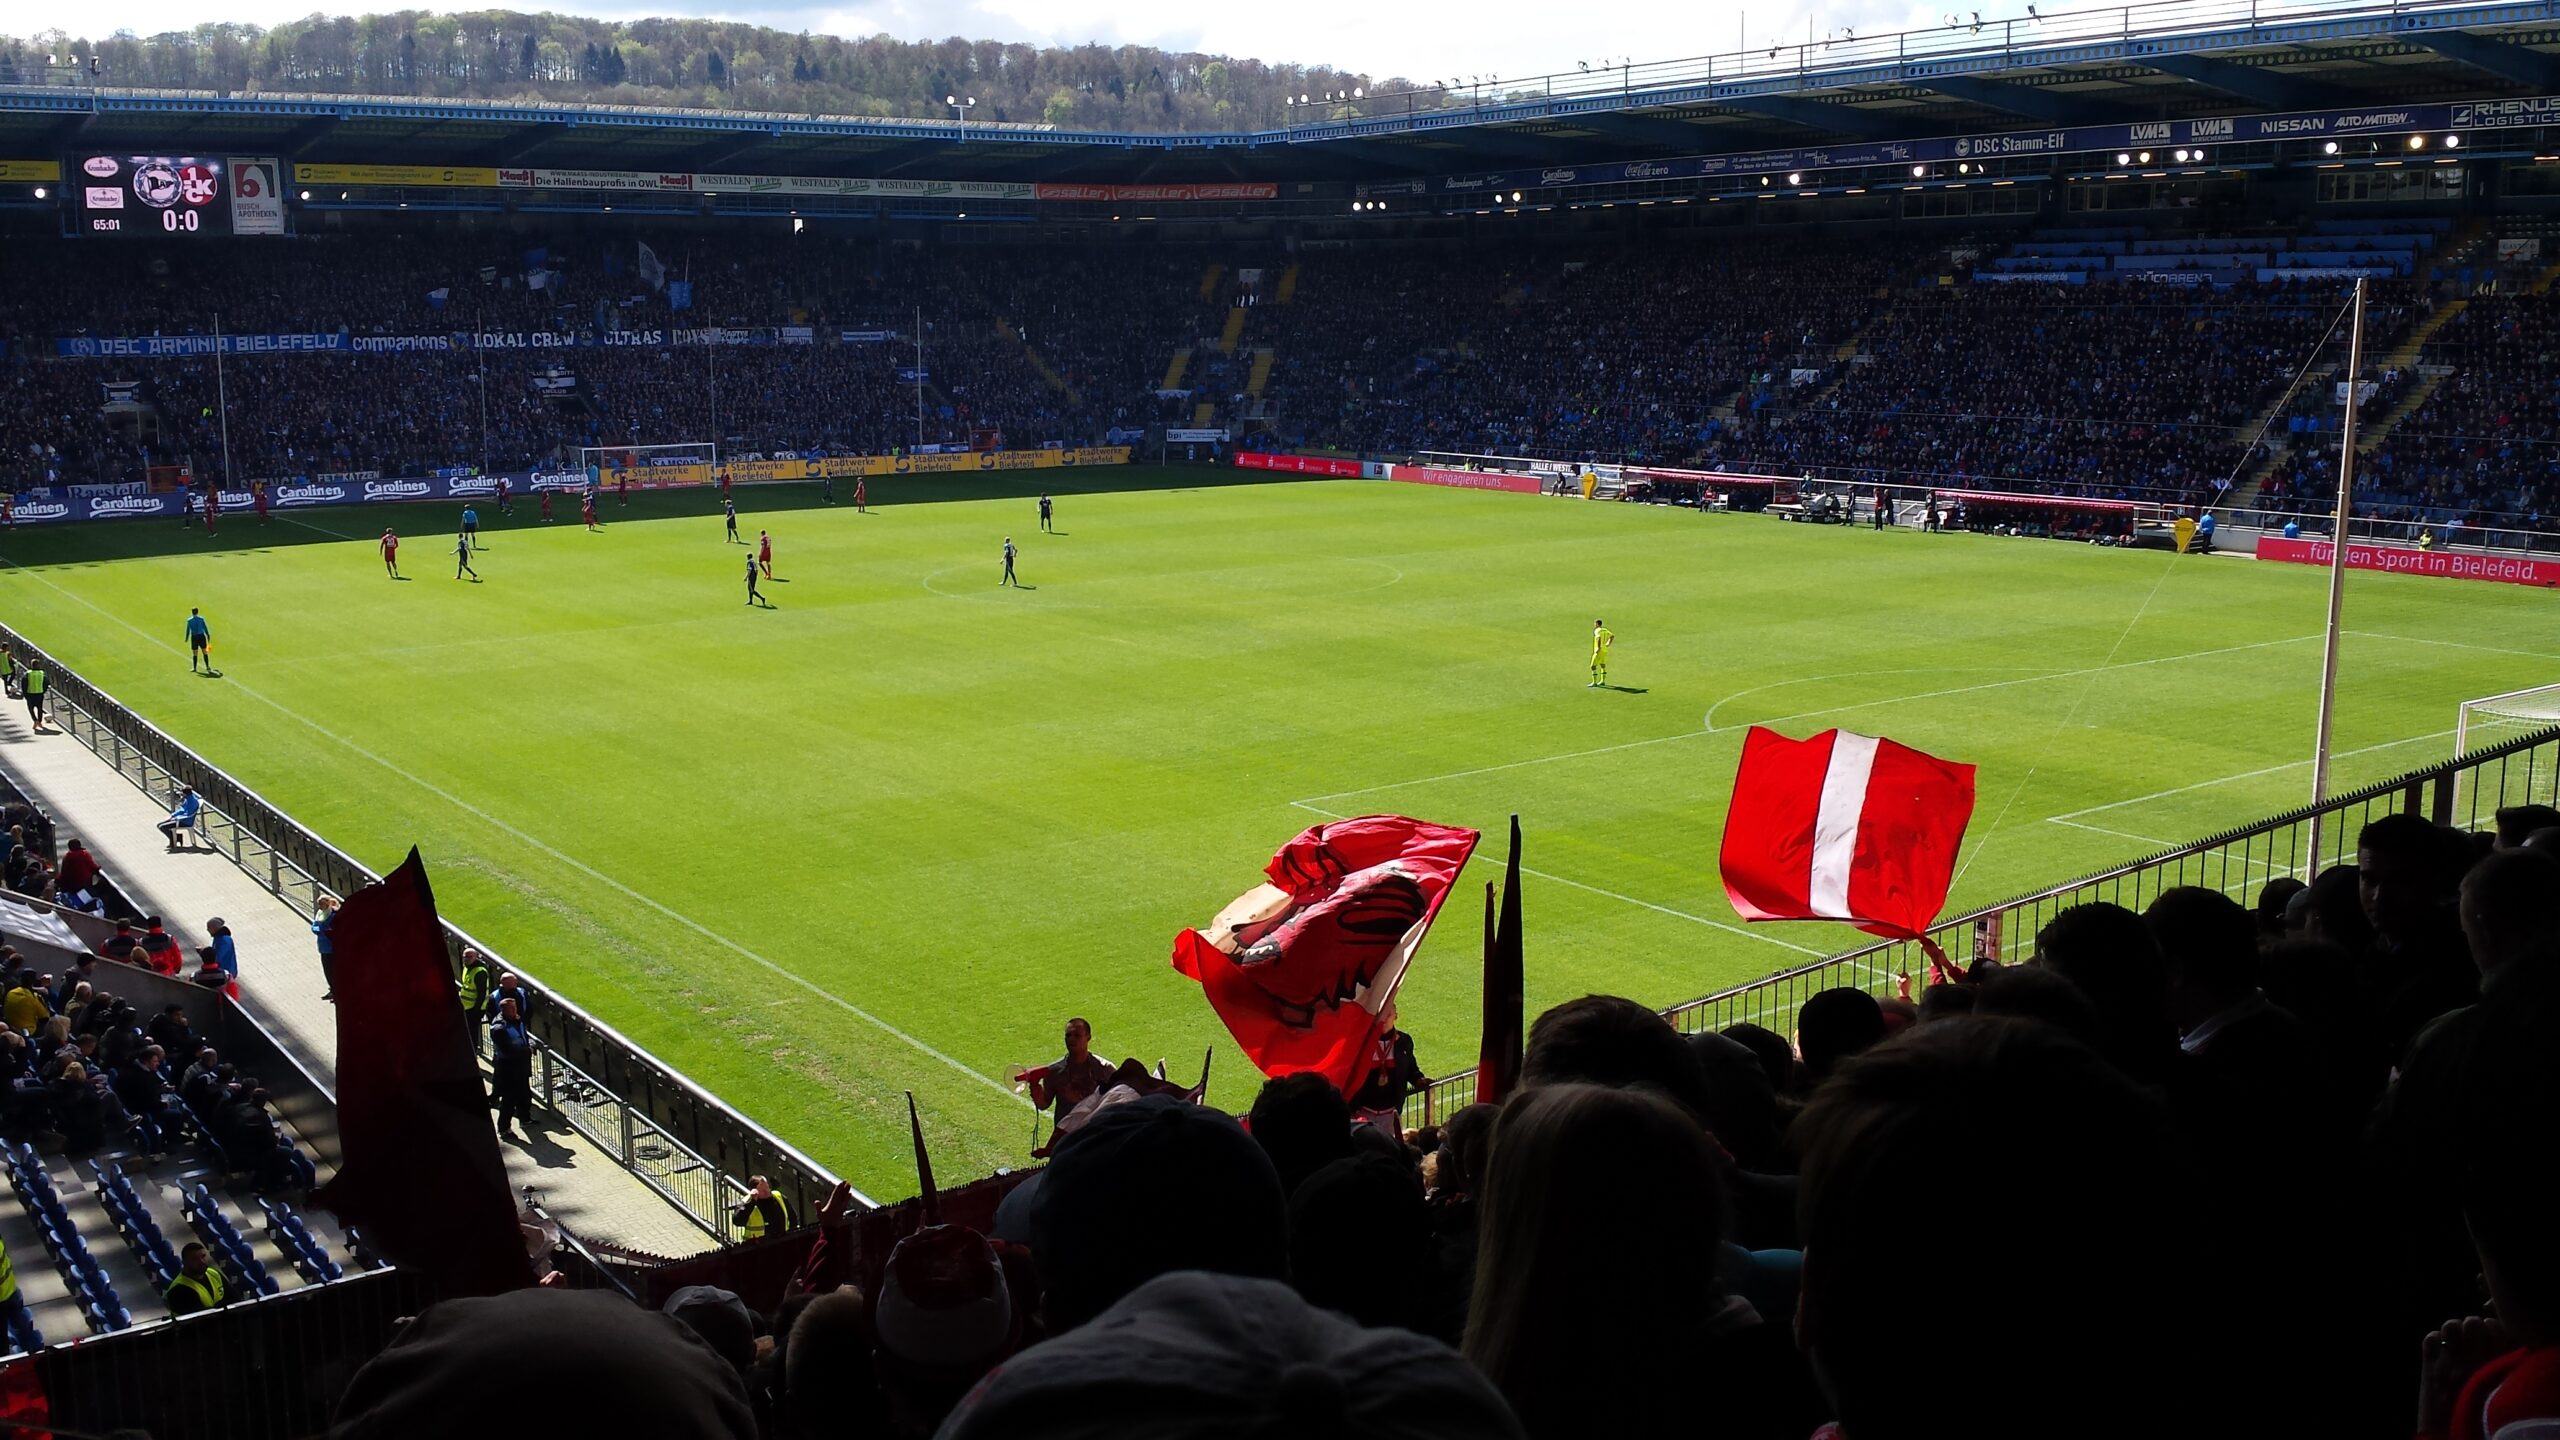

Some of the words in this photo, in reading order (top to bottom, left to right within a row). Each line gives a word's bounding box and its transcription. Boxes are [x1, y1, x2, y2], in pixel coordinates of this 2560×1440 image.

[2474, 98, 2560, 116] RHENUS
[2260, 118, 2325, 133] NISSAN
[2474, 112, 2560, 127] LOGISTICS
[2130, 124, 2159, 140] LVM
[2191, 120, 2220, 137] LVM
[1973, 138, 1999, 154] DSC
[2002, 133, 2065, 152] Stamm-Elf
[1652, 167, 1669, 177] zero
[536, 177, 552, 187] Die
[553, 178, 627, 189] Hallenbauprofis
[628, 179, 637, 187] in
[638, 179, 659, 189] OWL
[163, 209, 199, 231] 0:0
[237, 210, 278, 218] APOTHEKEN
[94, 219, 121, 231] 65:01
[100, 339, 141, 354] DSC
[148, 337, 229, 354] ARMINIA
[236, 334, 340, 352] BIELEFELD
[352, 333, 448, 353] companions
[473, 332, 526, 348] LOKAL
[532, 331, 575, 347] CREW
[603, 330, 662, 345] ULTRAS
[1167, 431, 1182, 440] bpi
[825, 457, 877, 468] Stadtwerke
[914, 453, 962, 463] Stadtwerke
[998, 451, 1044, 460] Stadtwerke
[632, 466, 689, 477] Stadtwerke
[731, 461, 784, 473] Stadtwerke
[915, 462, 952, 472] Bielefeld
[1531, 462, 1549, 471] HALLE
[530, 470, 589, 485] Carolinen
[732, 470, 774, 481] Bielefeld
[1423, 470, 1438, 481] Wir
[1438, 472, 1484, 489] engagieren
[1485, 477, 1501, 488] uns
[277, 483, 341, 499] Carolinen
[364, 480, 427, 496] Carolinen
[90, 495, 160, 512] Carolinen
[2310, 543, 2335, 562] für
[2376, 549, 2423, 572] Sport
[2429, 556, 2446, 571] in
[2451, 559, 2538, 581] Bielefeld.
